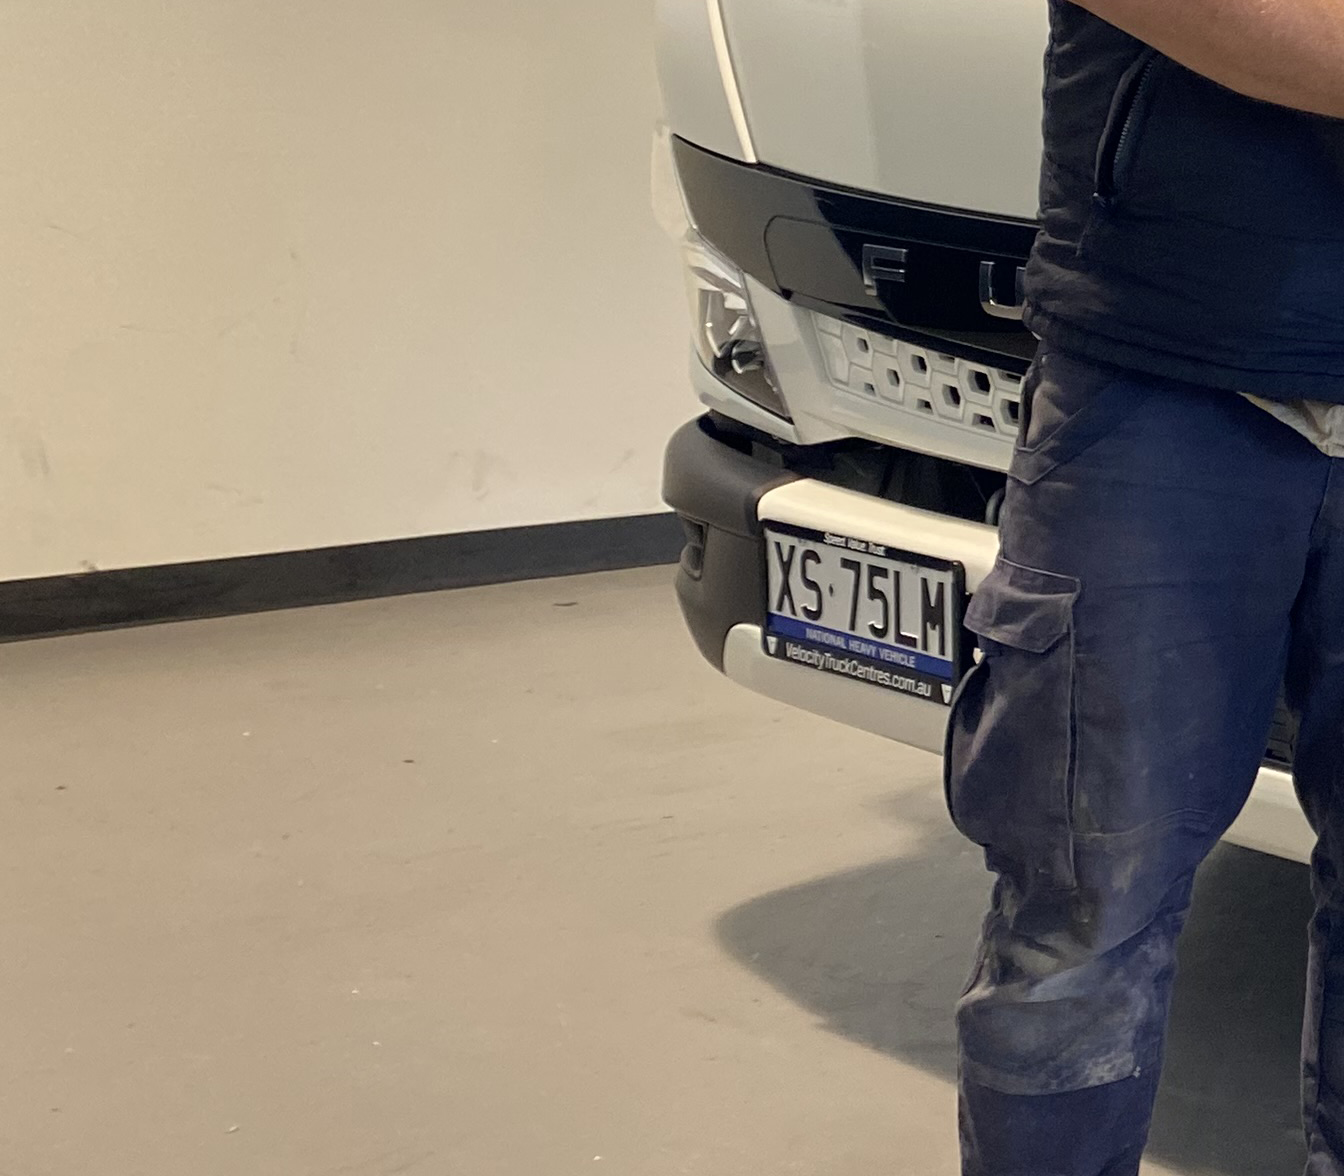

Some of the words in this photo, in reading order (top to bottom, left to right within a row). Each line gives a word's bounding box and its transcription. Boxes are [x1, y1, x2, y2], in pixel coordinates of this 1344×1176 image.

[862, 244, 1026, 320] FU
[785, 641, 932, 697] VelocityTruckCentres.com.au
[805, 628, 847, 650] NATIONAL
[849, 639, 876, 657] HEAVY
[879, 648, 916, 669] VEHICLE
